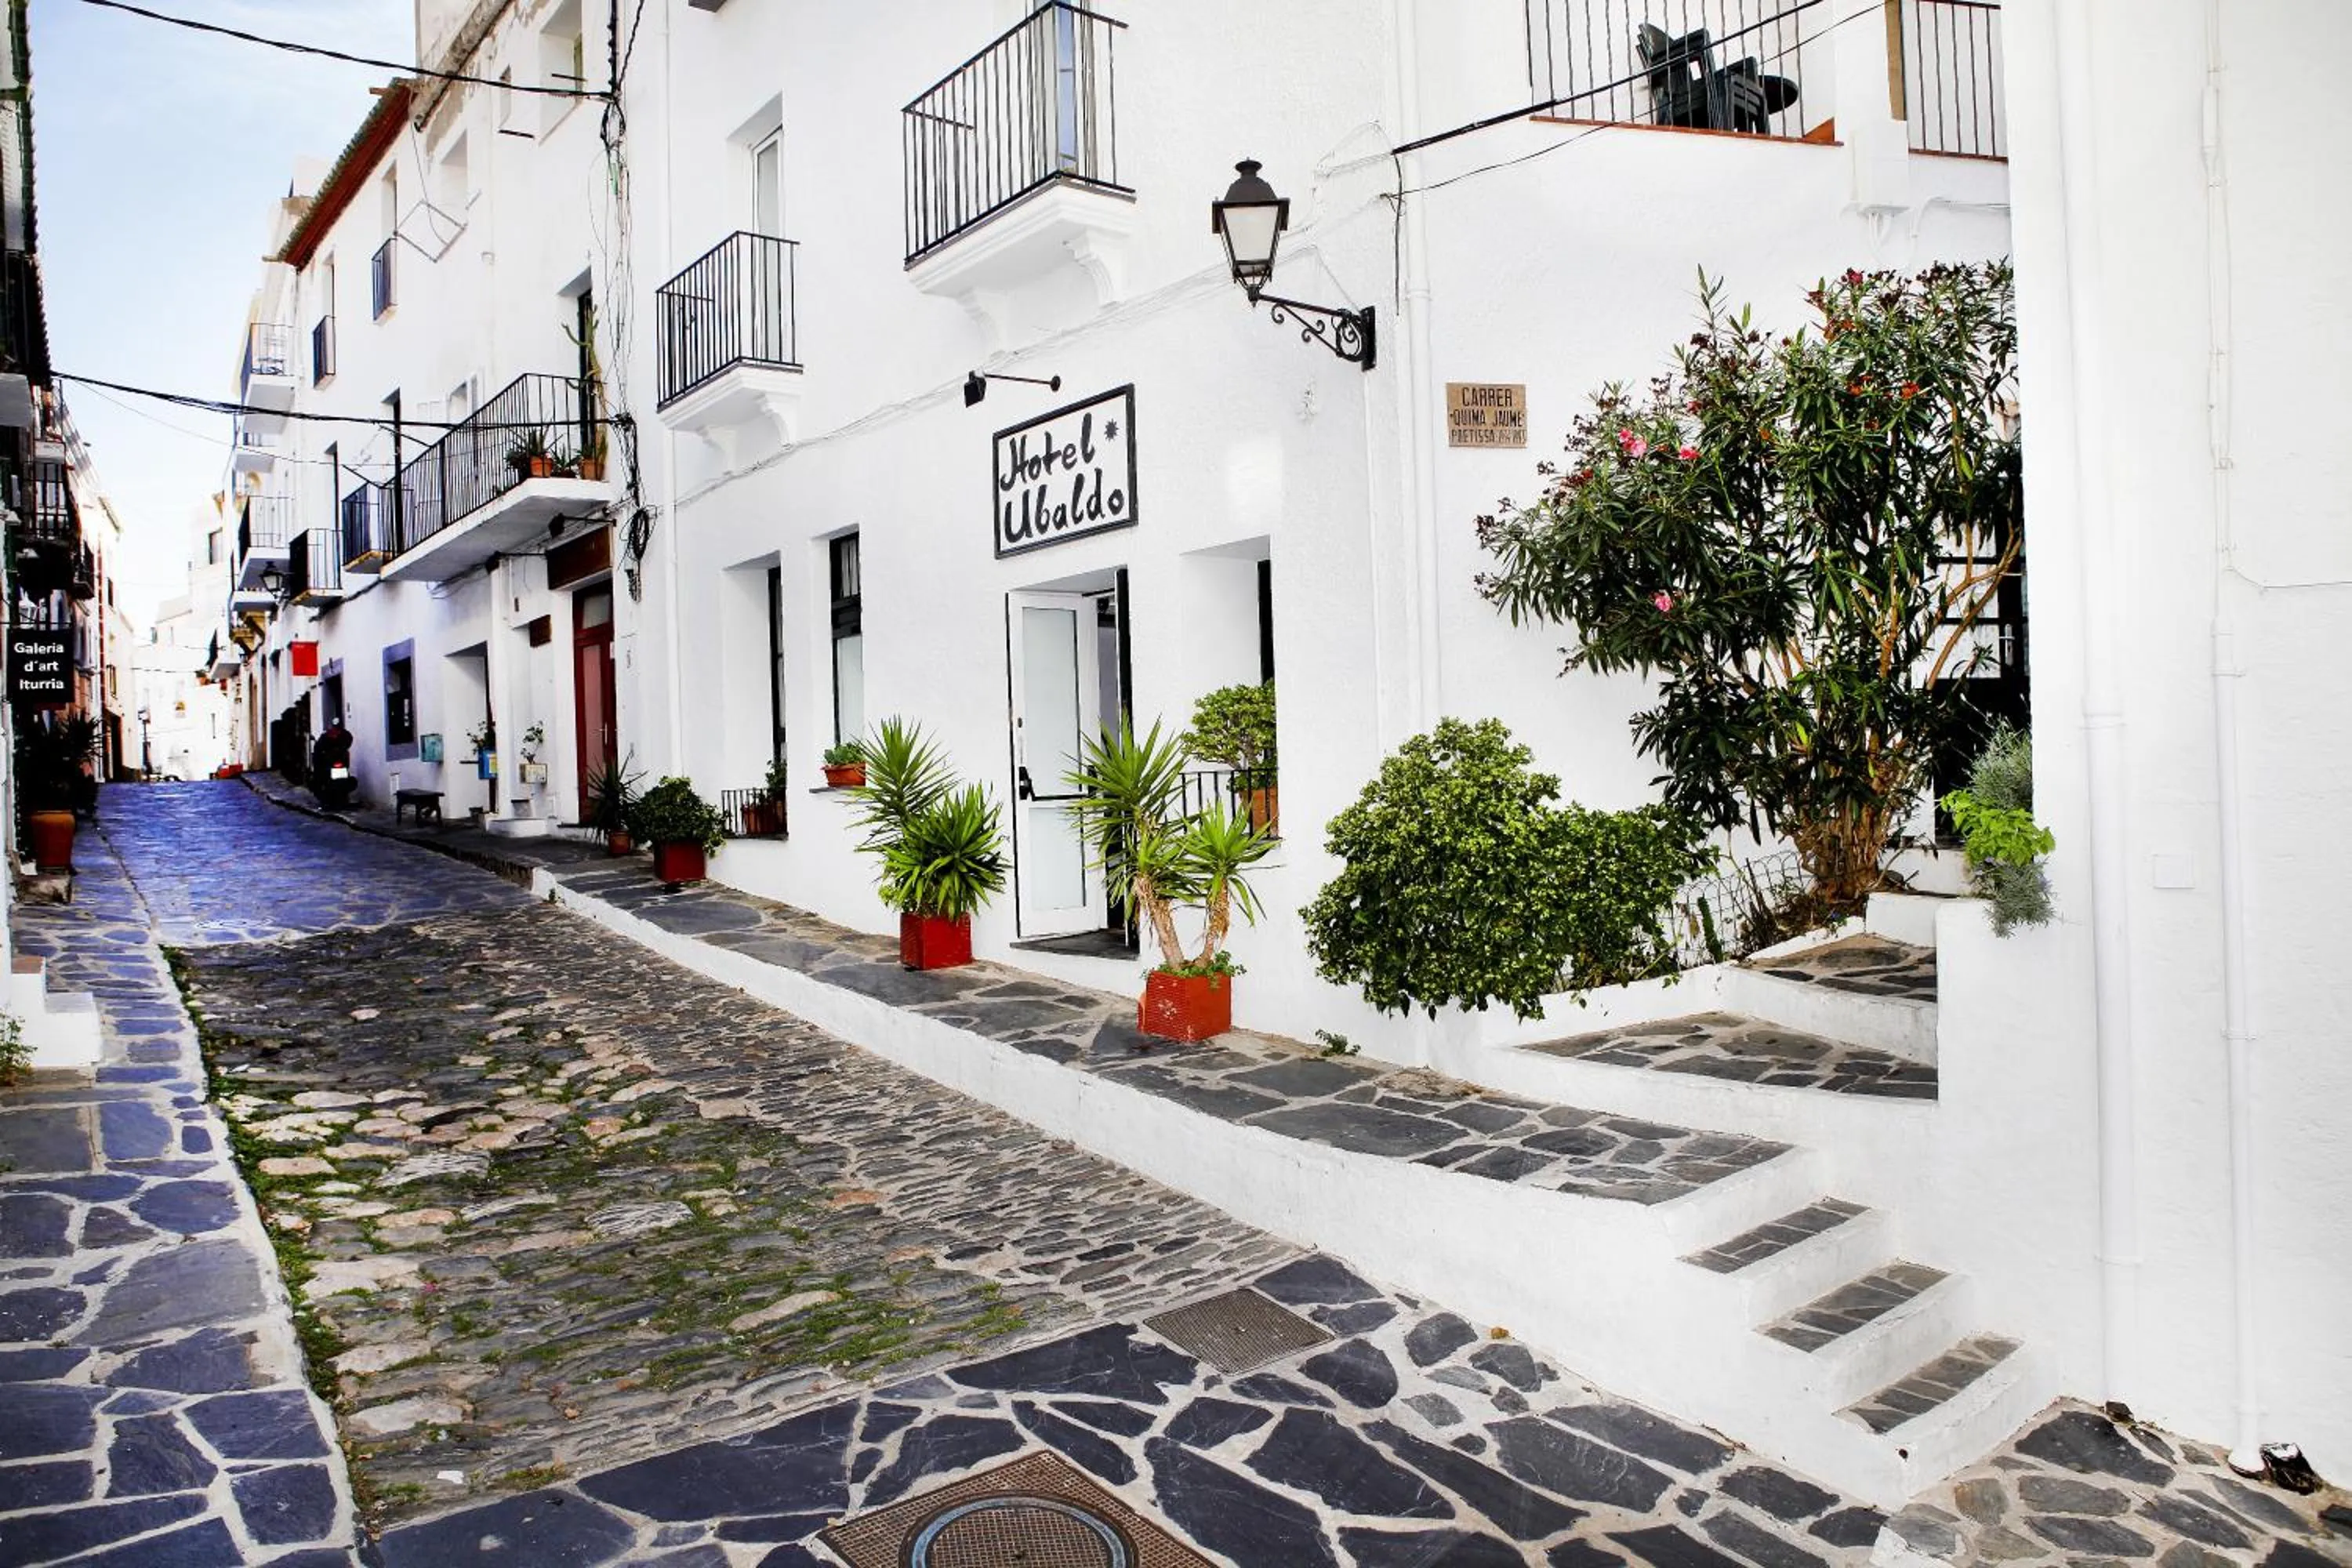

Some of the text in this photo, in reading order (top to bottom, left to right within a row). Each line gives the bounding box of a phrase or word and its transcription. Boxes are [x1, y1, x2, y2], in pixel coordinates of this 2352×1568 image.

[1461, 387, 1512, 407] CARRER
[1000, 412, 1095, 492] Hotel
[1004, 467, 1124, 543] Ubaldo
[13, 642, 64, 655] Galeria
[19, 679, 65, 690] Iturria
